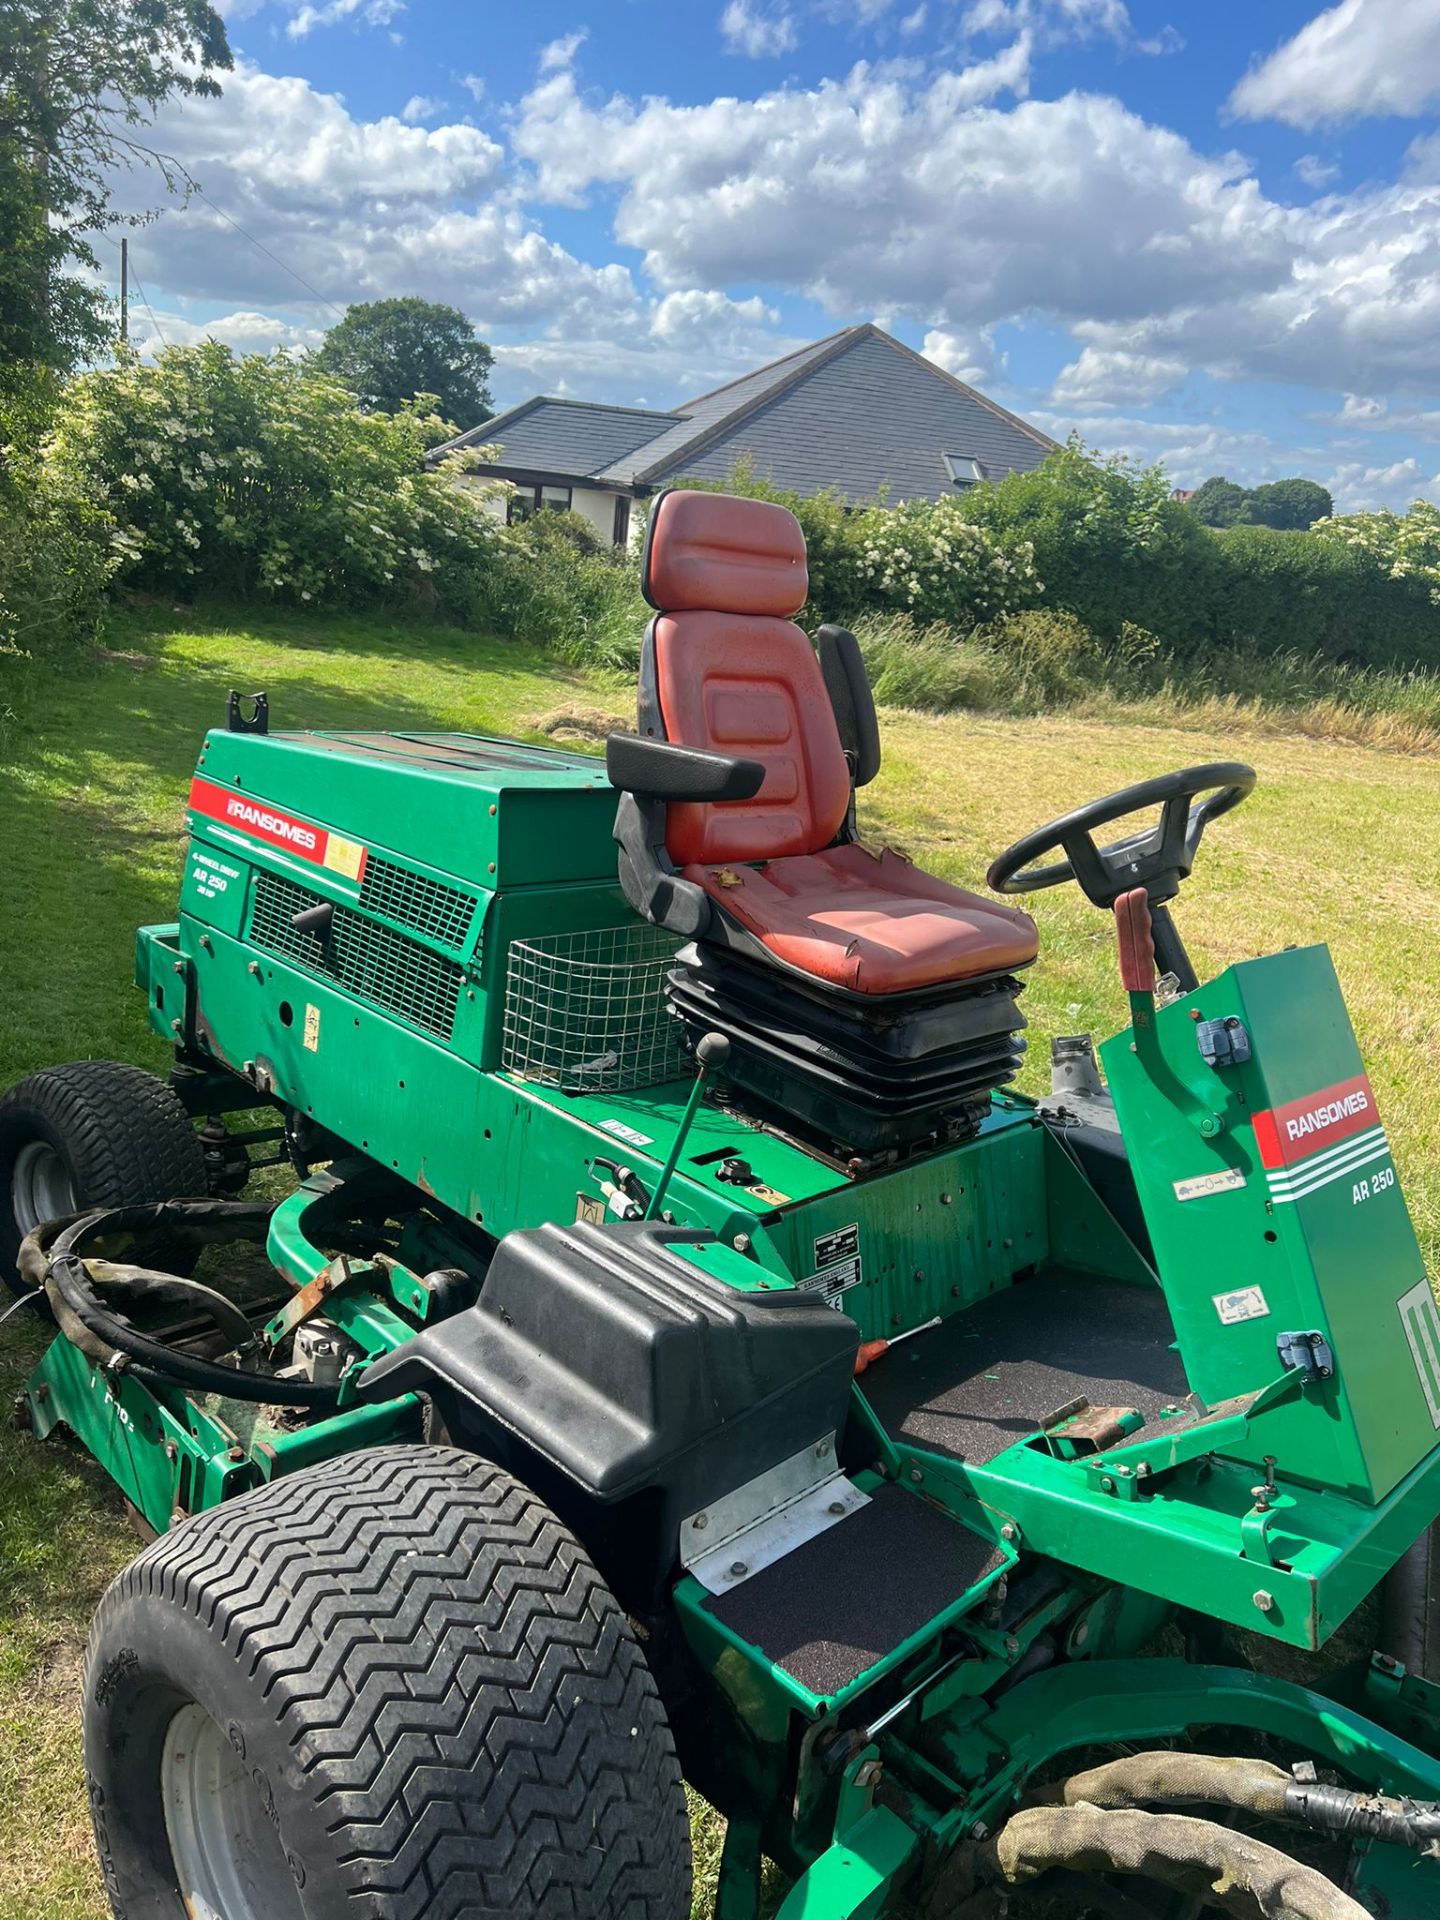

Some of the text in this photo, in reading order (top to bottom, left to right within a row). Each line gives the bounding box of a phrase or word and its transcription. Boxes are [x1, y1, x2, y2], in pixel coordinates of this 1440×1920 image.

[233, 801, 316, 850] RANSOMES
[192, 867, 227, 892] AR 250
[1286, 1090, 1368, 1141] RANSOMES
[1352, 1167, 1395, 1205] AR 250
